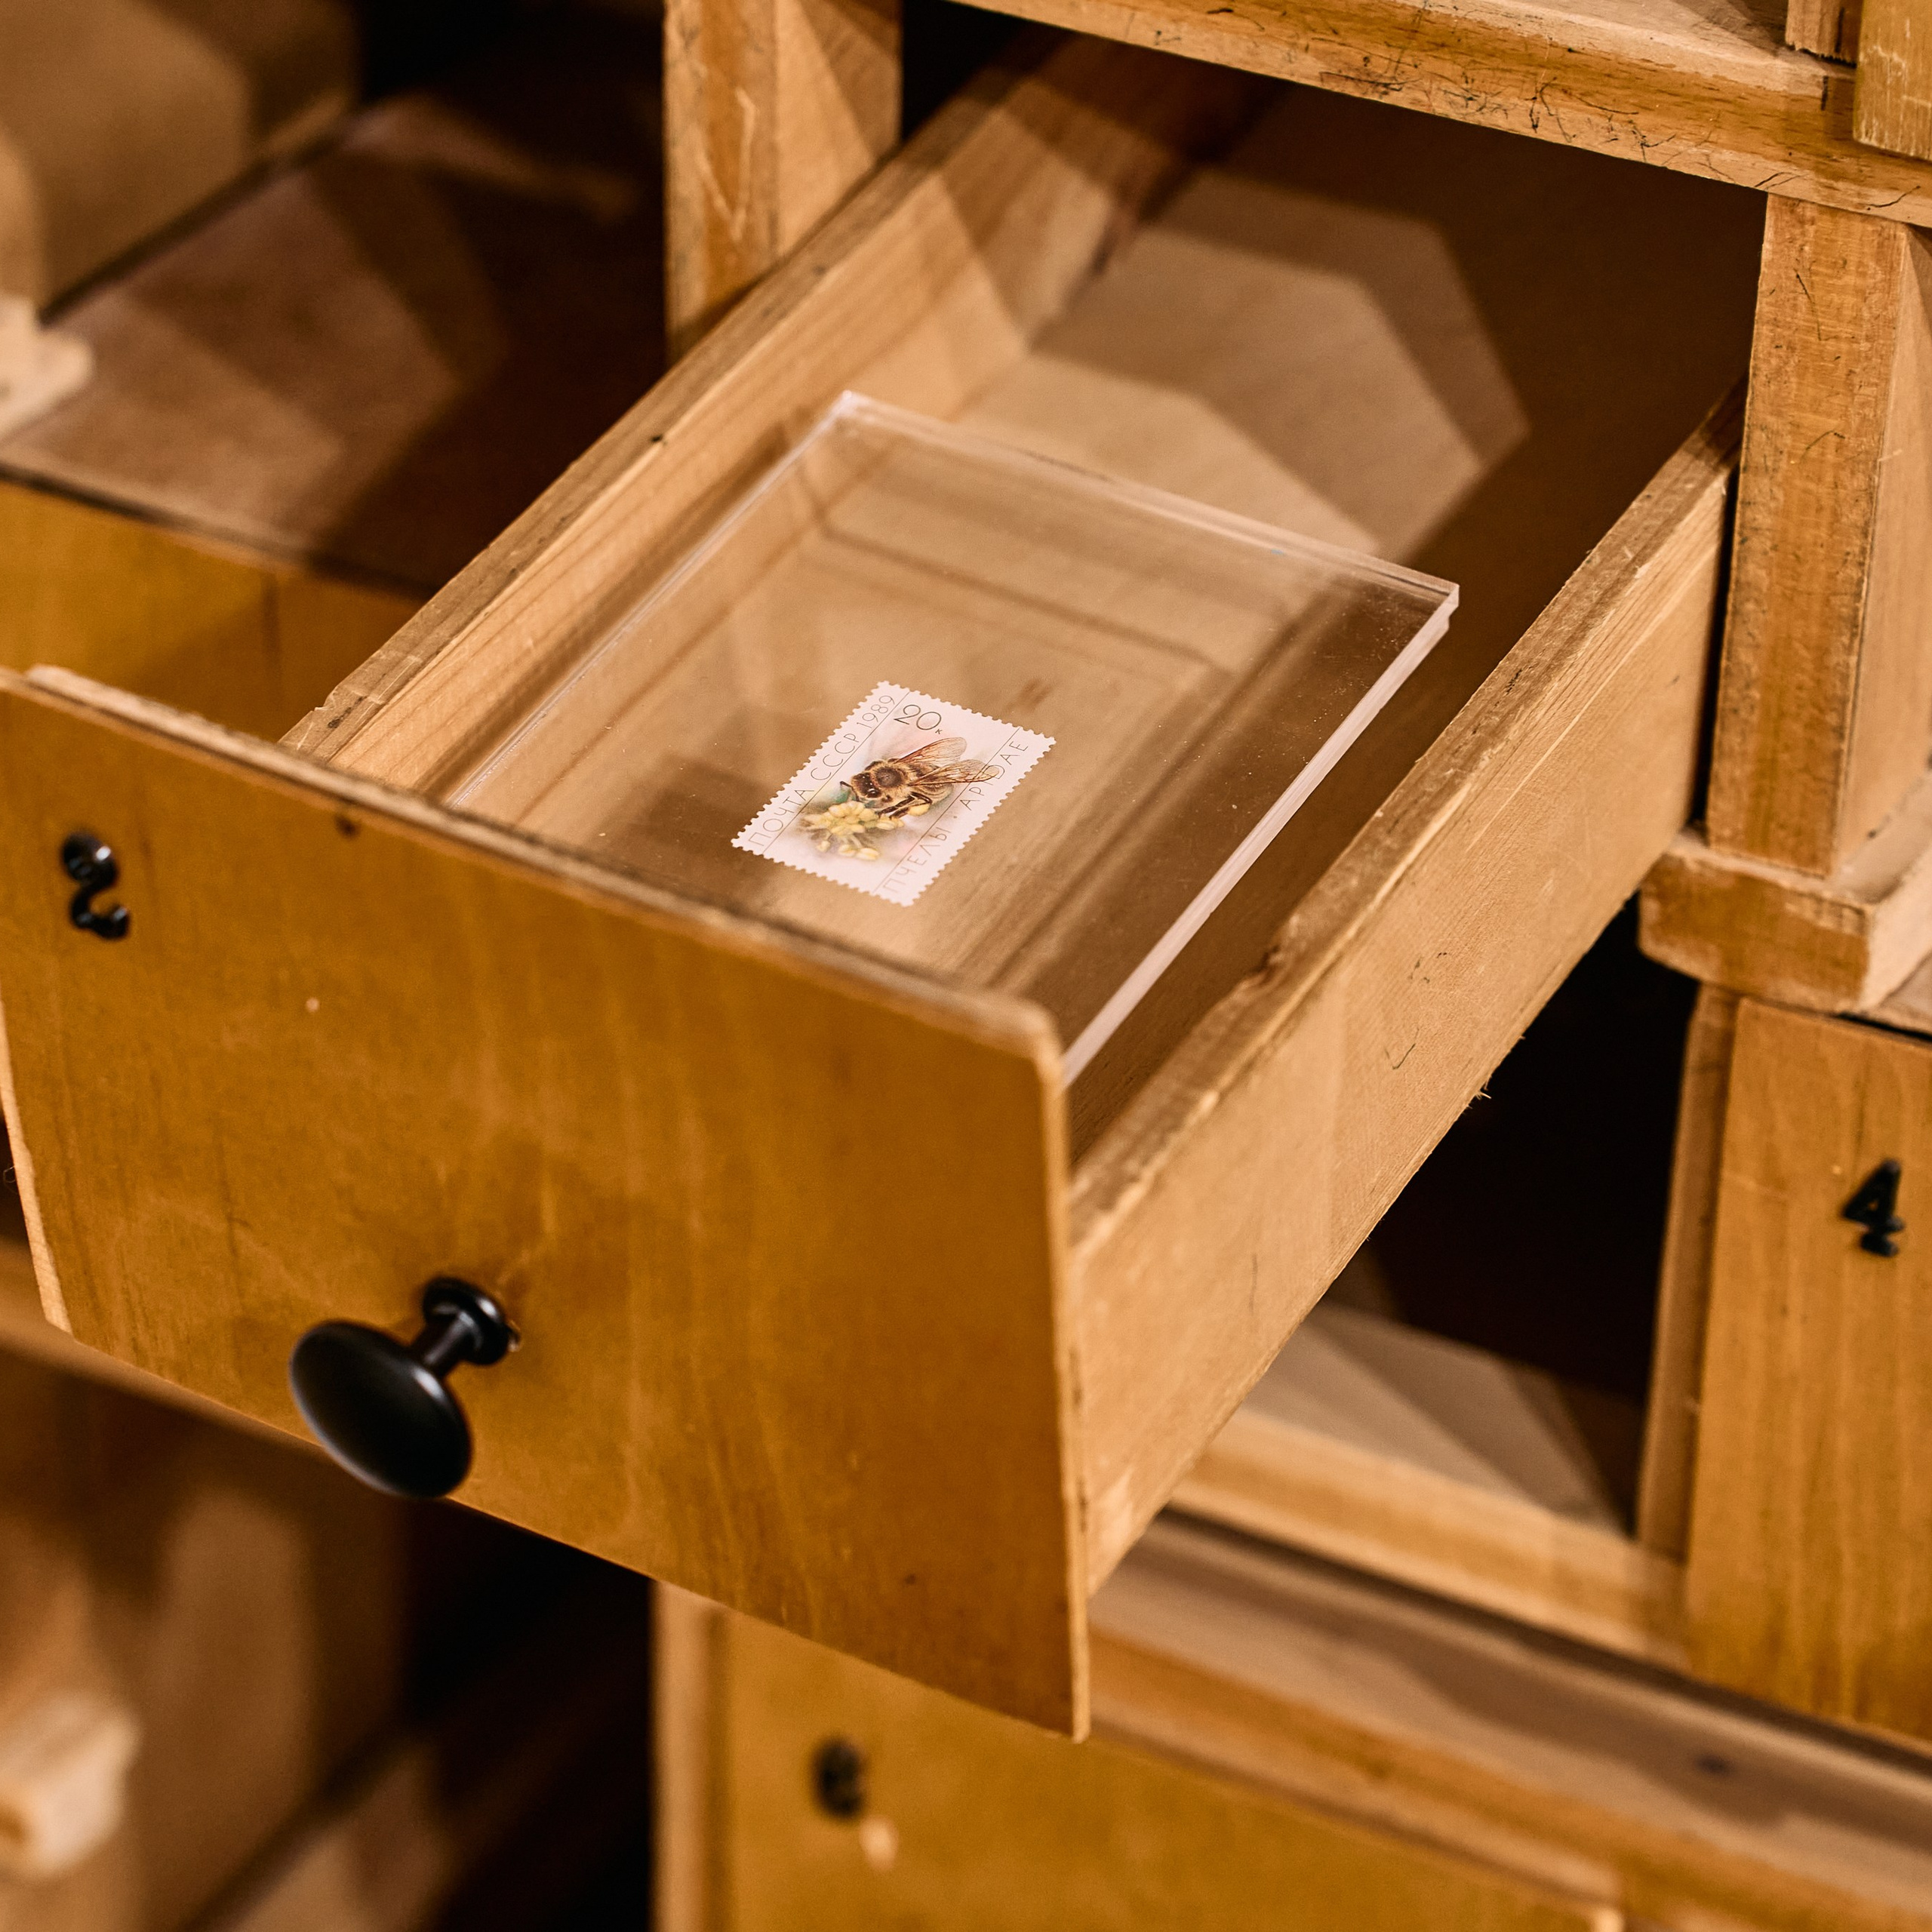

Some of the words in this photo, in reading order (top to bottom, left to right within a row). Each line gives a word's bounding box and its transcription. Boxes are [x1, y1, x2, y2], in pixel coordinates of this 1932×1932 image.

[748, 789, 815, 847] ПОЧТА
[811, 733, 860, 780] СССР
[856, 695, 895, 729] 1989
[883, 826, 952, 894] ПЧЕЛЫ
[1840, 1158, 1906, 1257] 4
